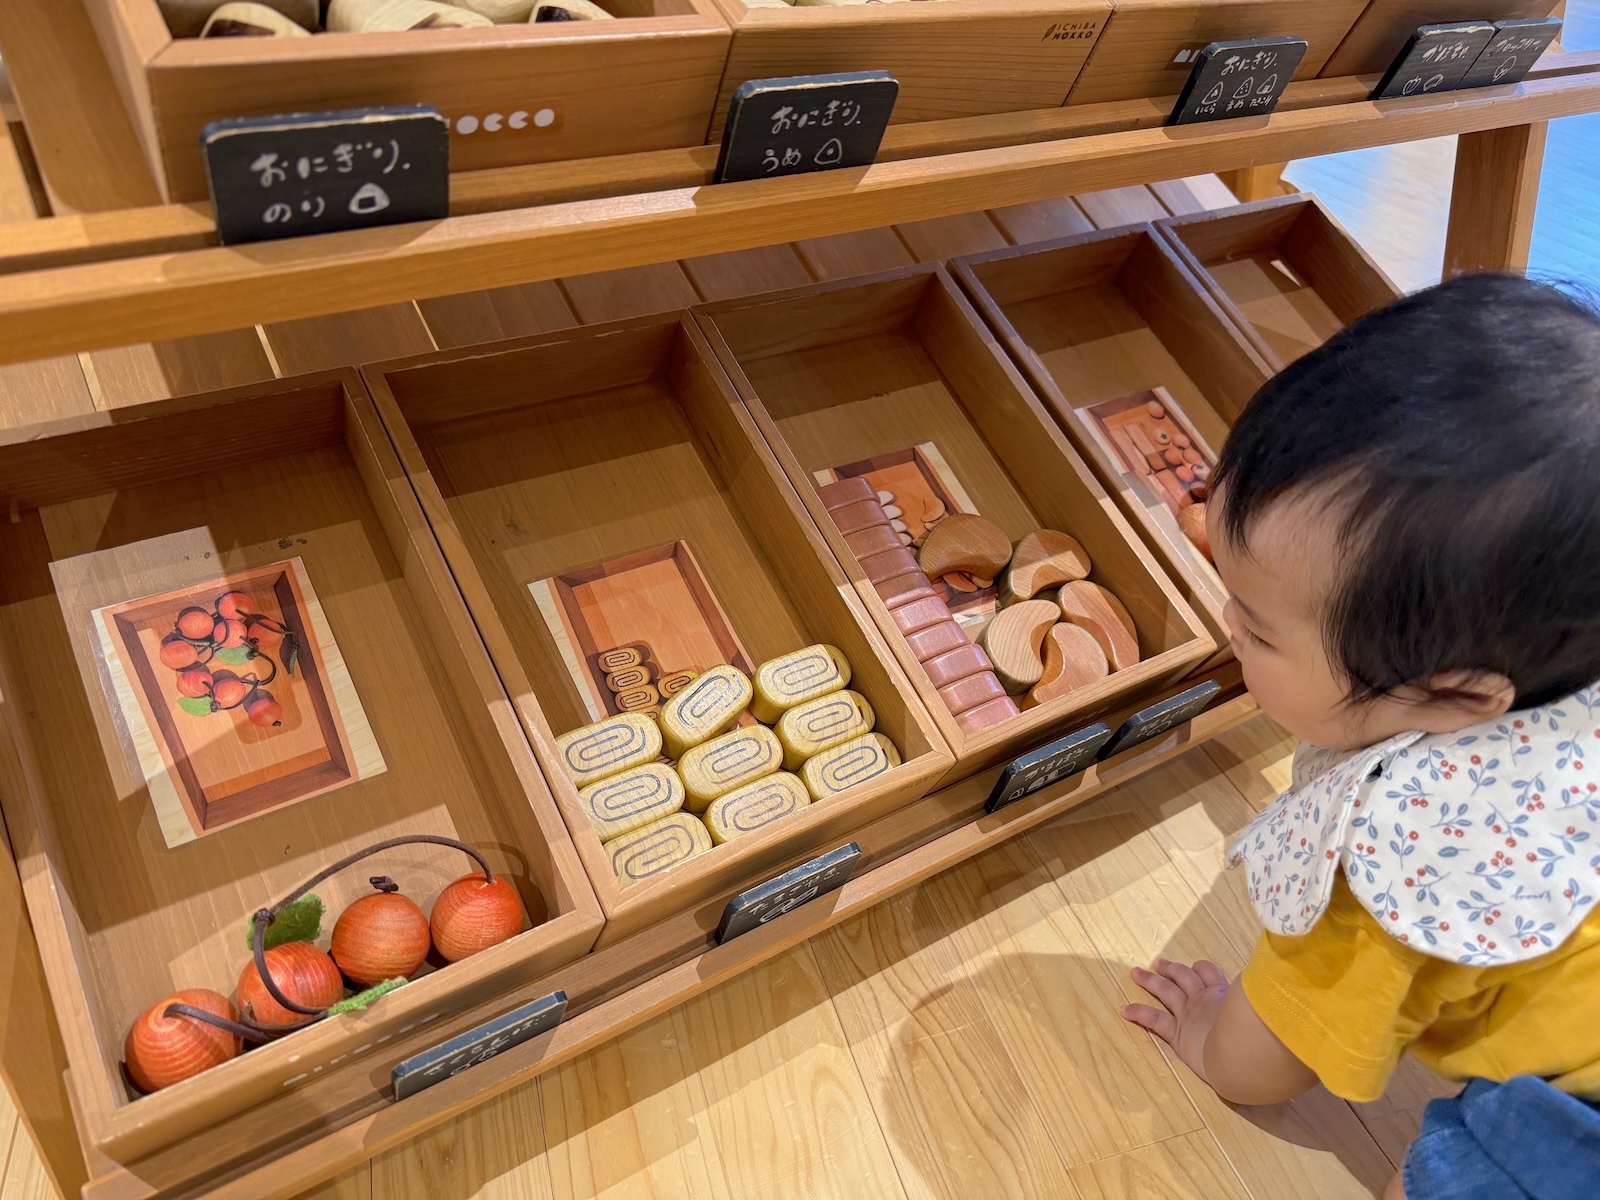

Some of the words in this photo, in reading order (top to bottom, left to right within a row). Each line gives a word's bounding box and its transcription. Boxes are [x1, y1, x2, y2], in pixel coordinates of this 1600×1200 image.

[1057, 22, 1096, 31] ICHIBA
[1052, 31, 1093, 40] MOKKO
[1195, 103, 1216, 115] いくら
[1226, 99, 1244, 112] まめ
[762, 148, 801, 172] うめ
[263, 197, 325, 223] のり
